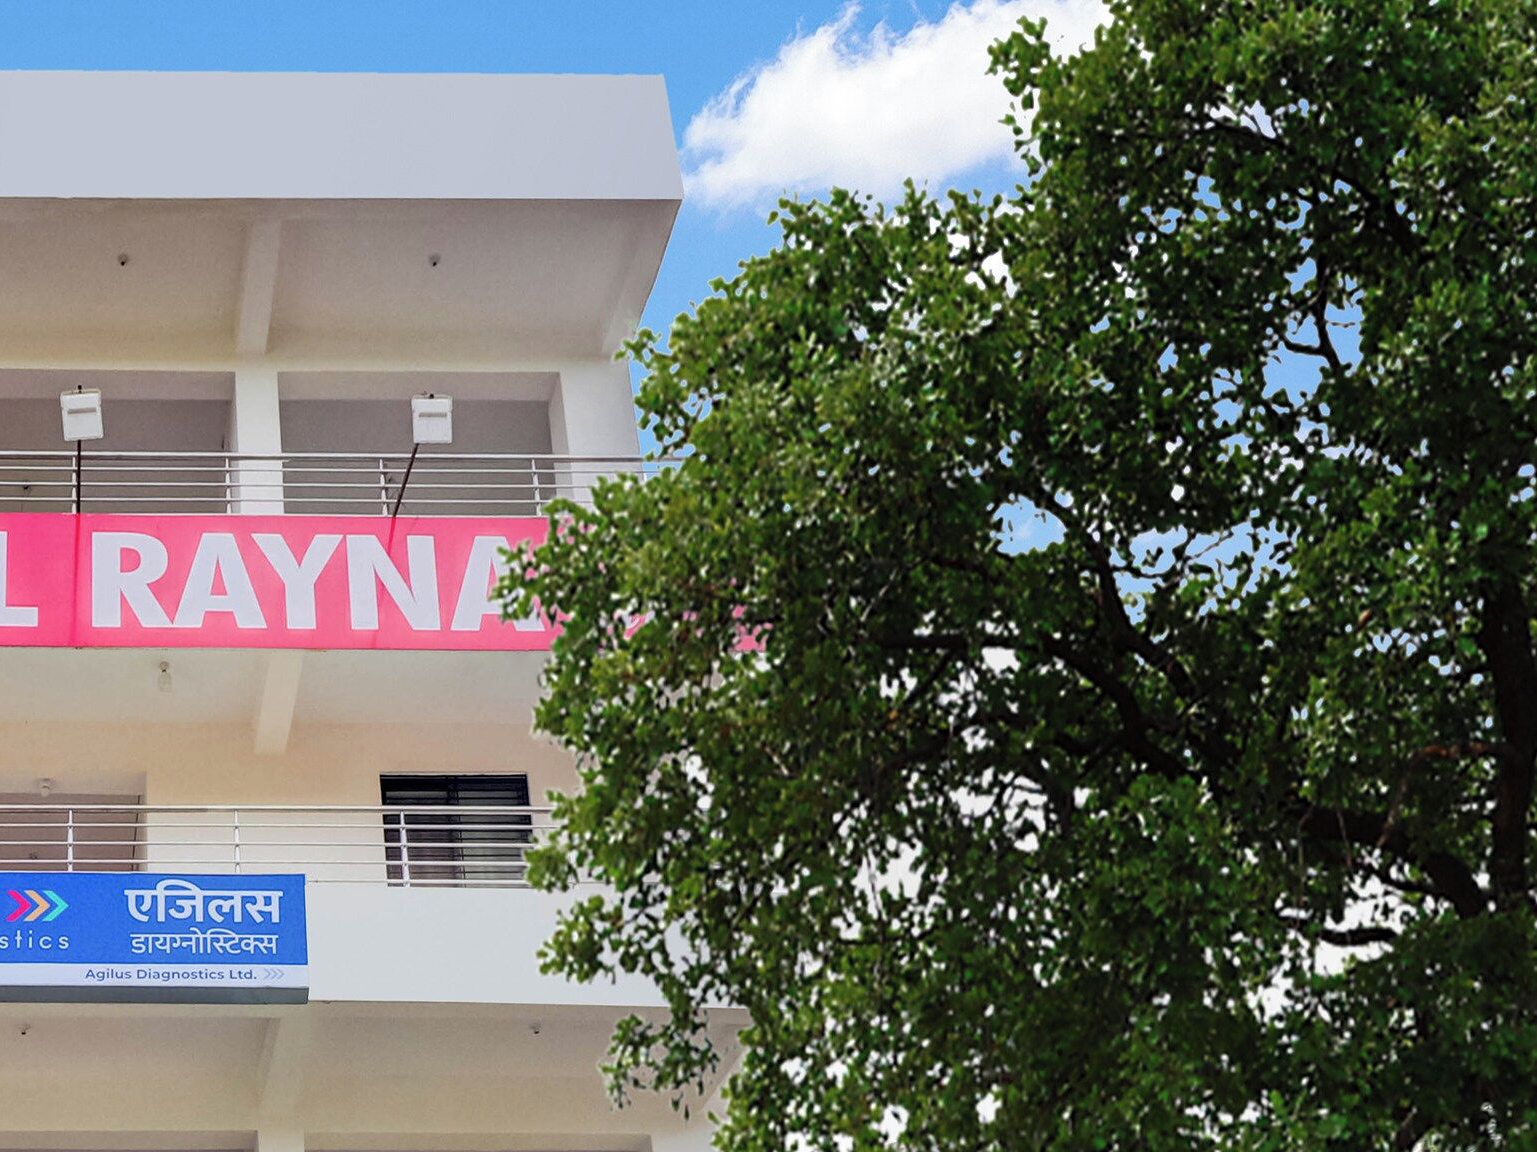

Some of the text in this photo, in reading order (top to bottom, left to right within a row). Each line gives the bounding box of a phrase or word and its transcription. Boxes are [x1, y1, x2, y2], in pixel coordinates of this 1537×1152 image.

[90, 530, 546, 632] RAYNA
[123, 878, 284, 924] एजिलस
[129, 926, 279, 955] डायग्नोस्टिक्स
[85, 968, 258, 982] Agilus Diagnostics Ltd.
